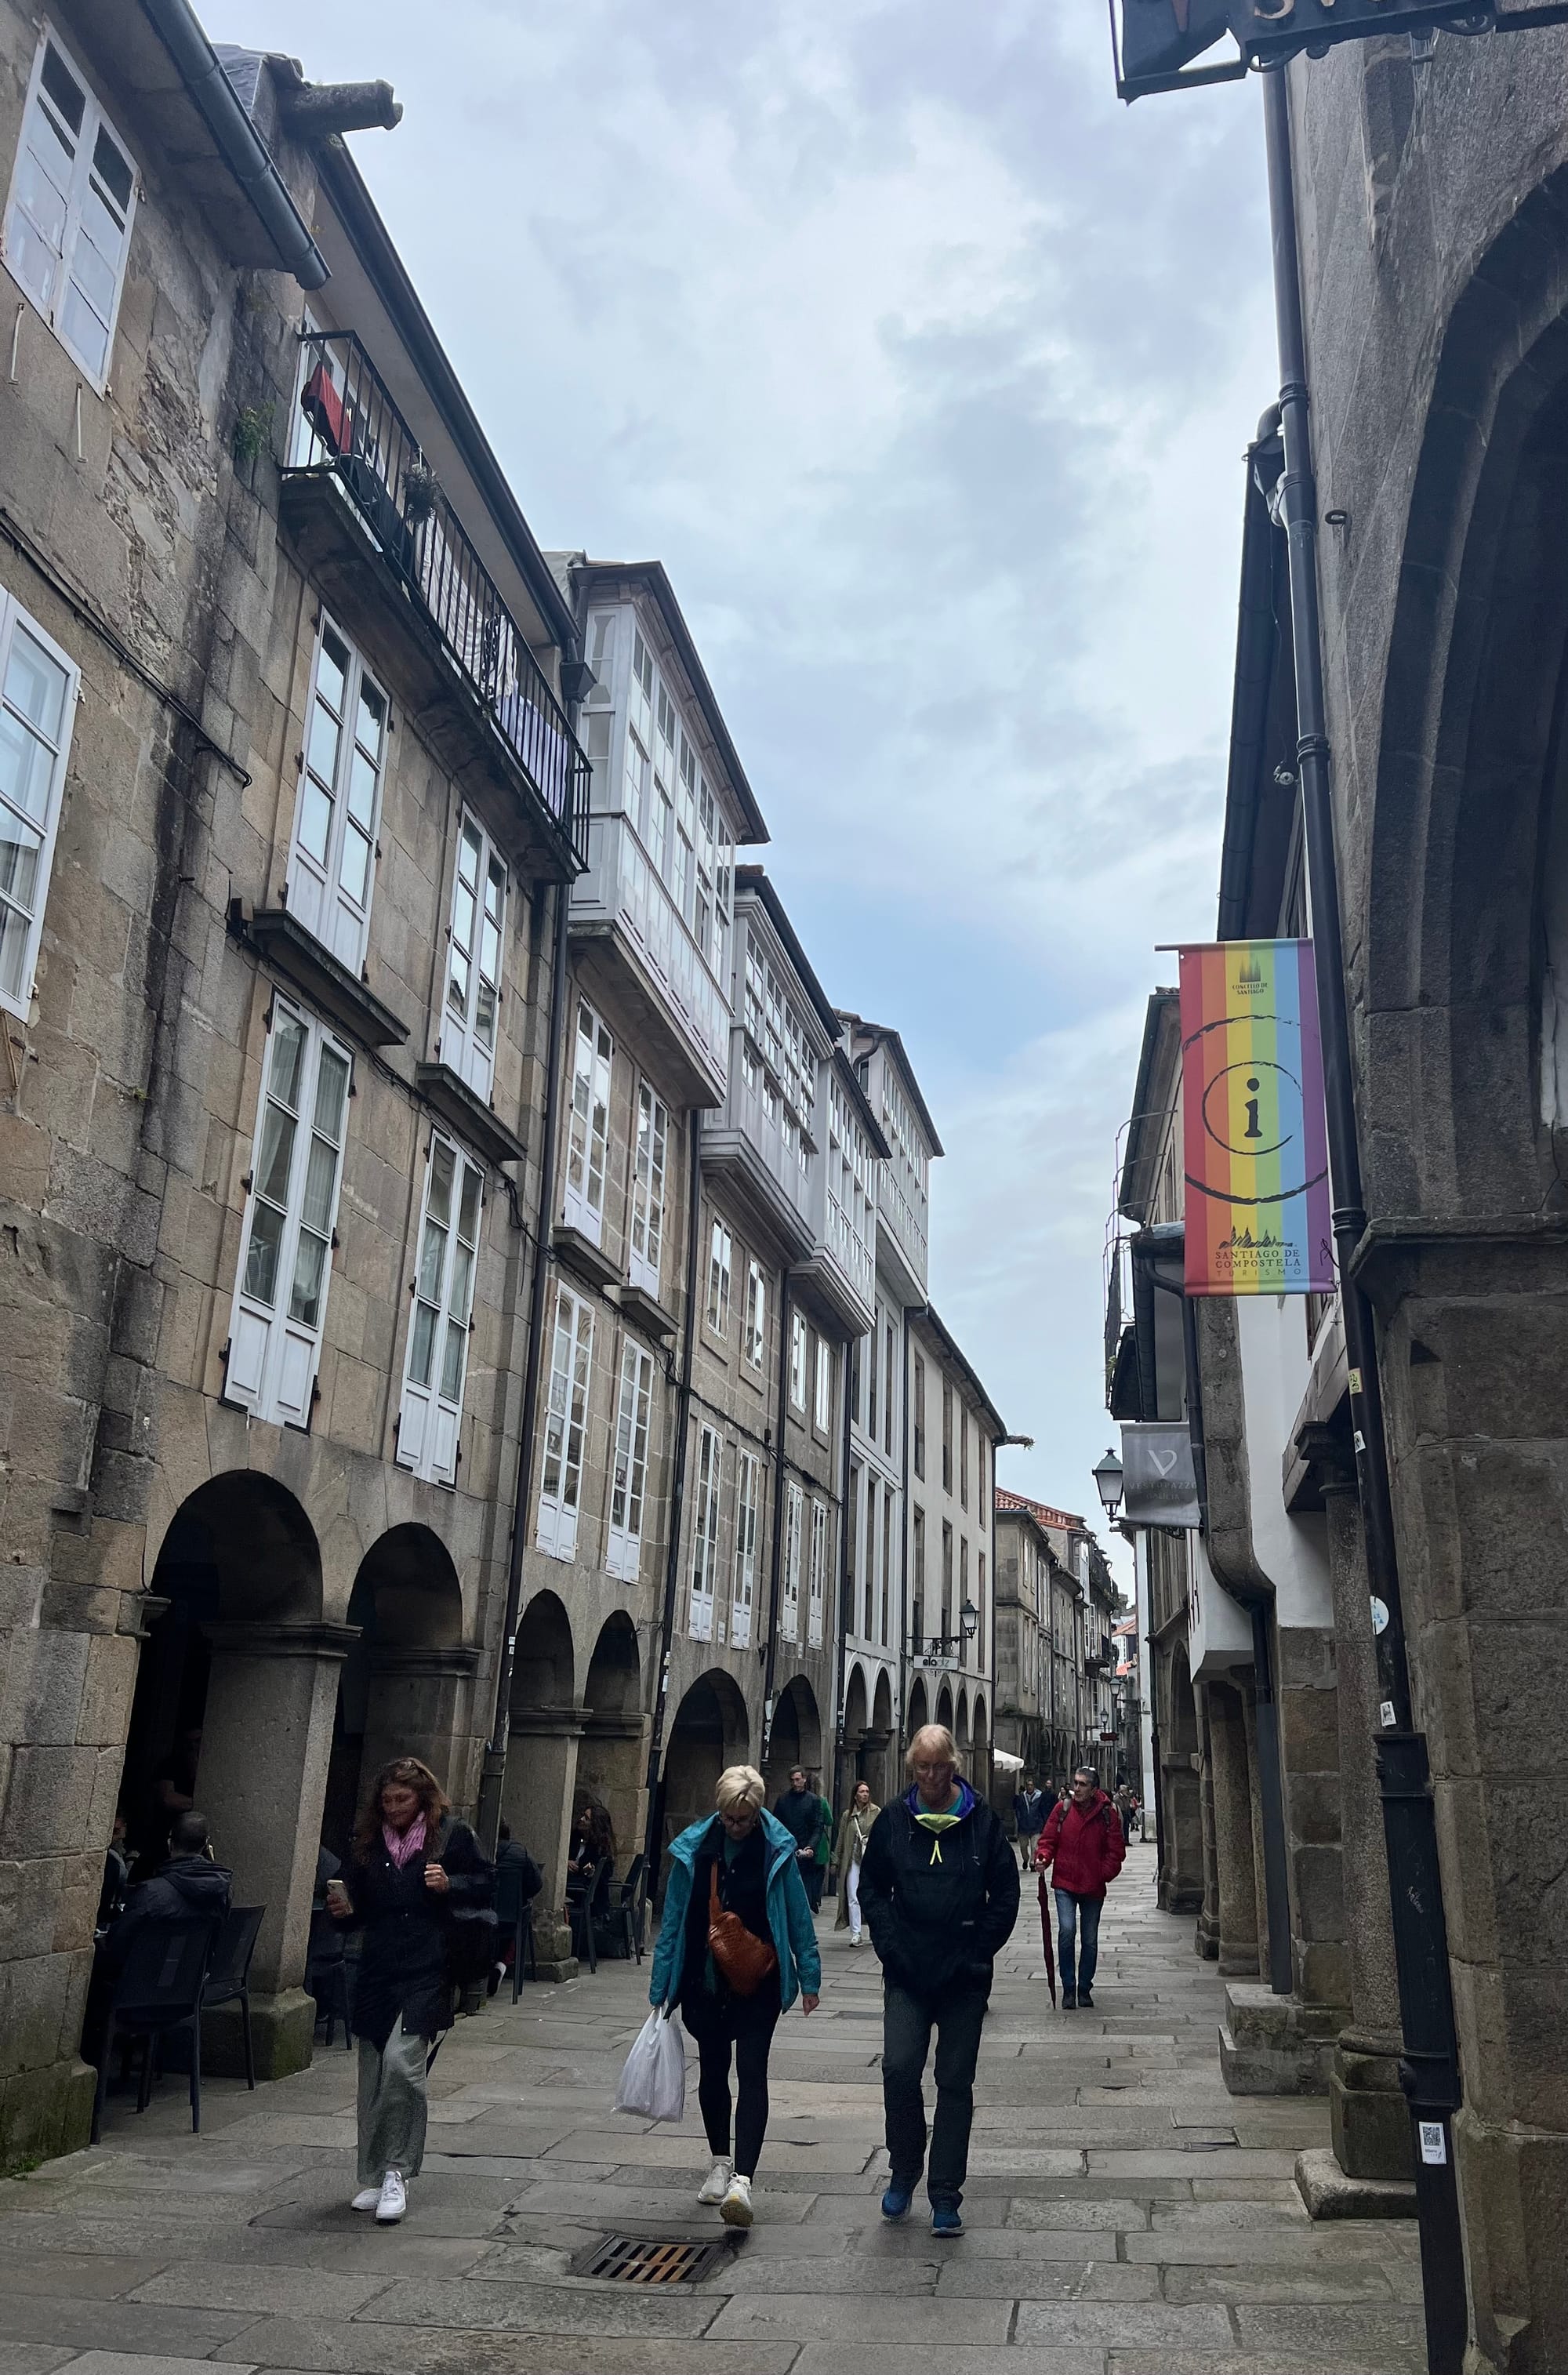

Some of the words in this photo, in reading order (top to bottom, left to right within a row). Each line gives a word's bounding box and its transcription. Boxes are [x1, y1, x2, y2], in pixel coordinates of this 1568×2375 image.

[1243, 1077, 1262, 1138] i
[1215, 1250, 1279, 1259] SANTIAGO
[1284, 1249, 1300, 1258] DE
[1215, 1258, 1301, 1269] COMPOSTELA
